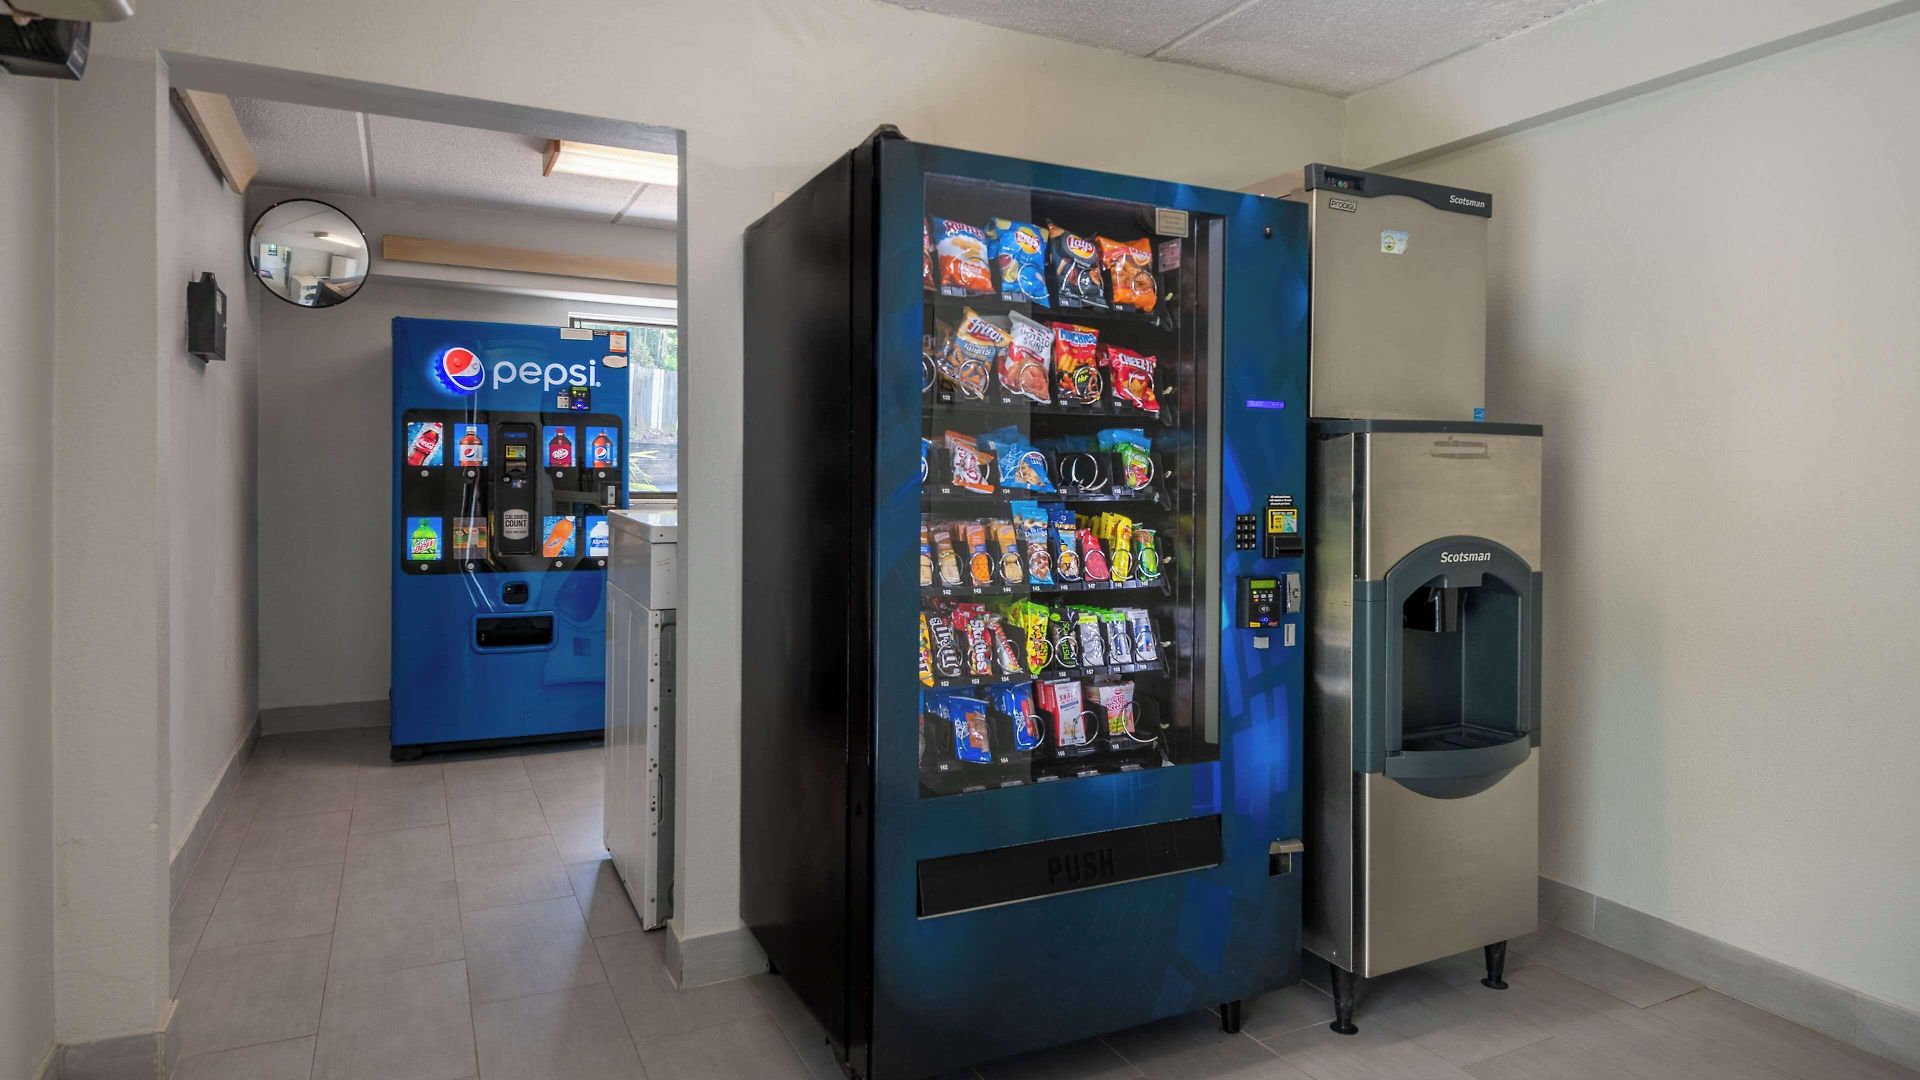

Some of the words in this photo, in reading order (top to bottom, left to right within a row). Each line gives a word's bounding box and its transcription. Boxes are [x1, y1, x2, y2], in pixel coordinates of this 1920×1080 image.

[1449, 194, 1486, 208] Scotsman
[1021, 329, 1050, 348] POTATO
[1023, 337, 1045, 353] SKINS
[1440, 551, 1491, 563] Scotsman
[970, 619, 988, 671] Skittles
[1048, 848, 1115, 885] PUSH
